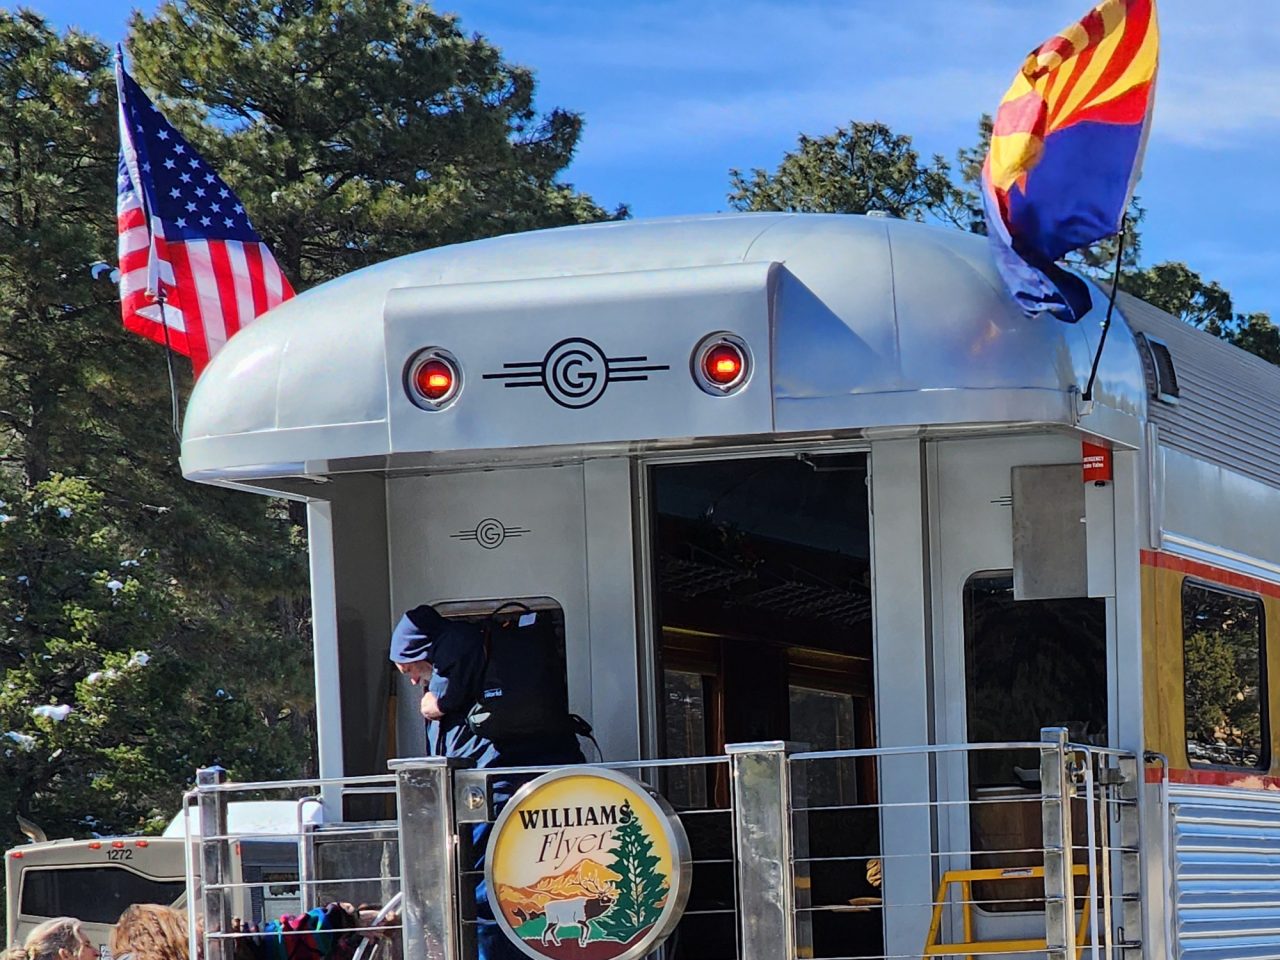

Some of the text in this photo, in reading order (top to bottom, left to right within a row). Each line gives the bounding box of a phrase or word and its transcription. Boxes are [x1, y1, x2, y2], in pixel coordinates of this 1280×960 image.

[519, 803, 633, 830] WILLIAMS
[106, 849, 133, 860] 1272
[536, 828, 613, 870] Flyer
